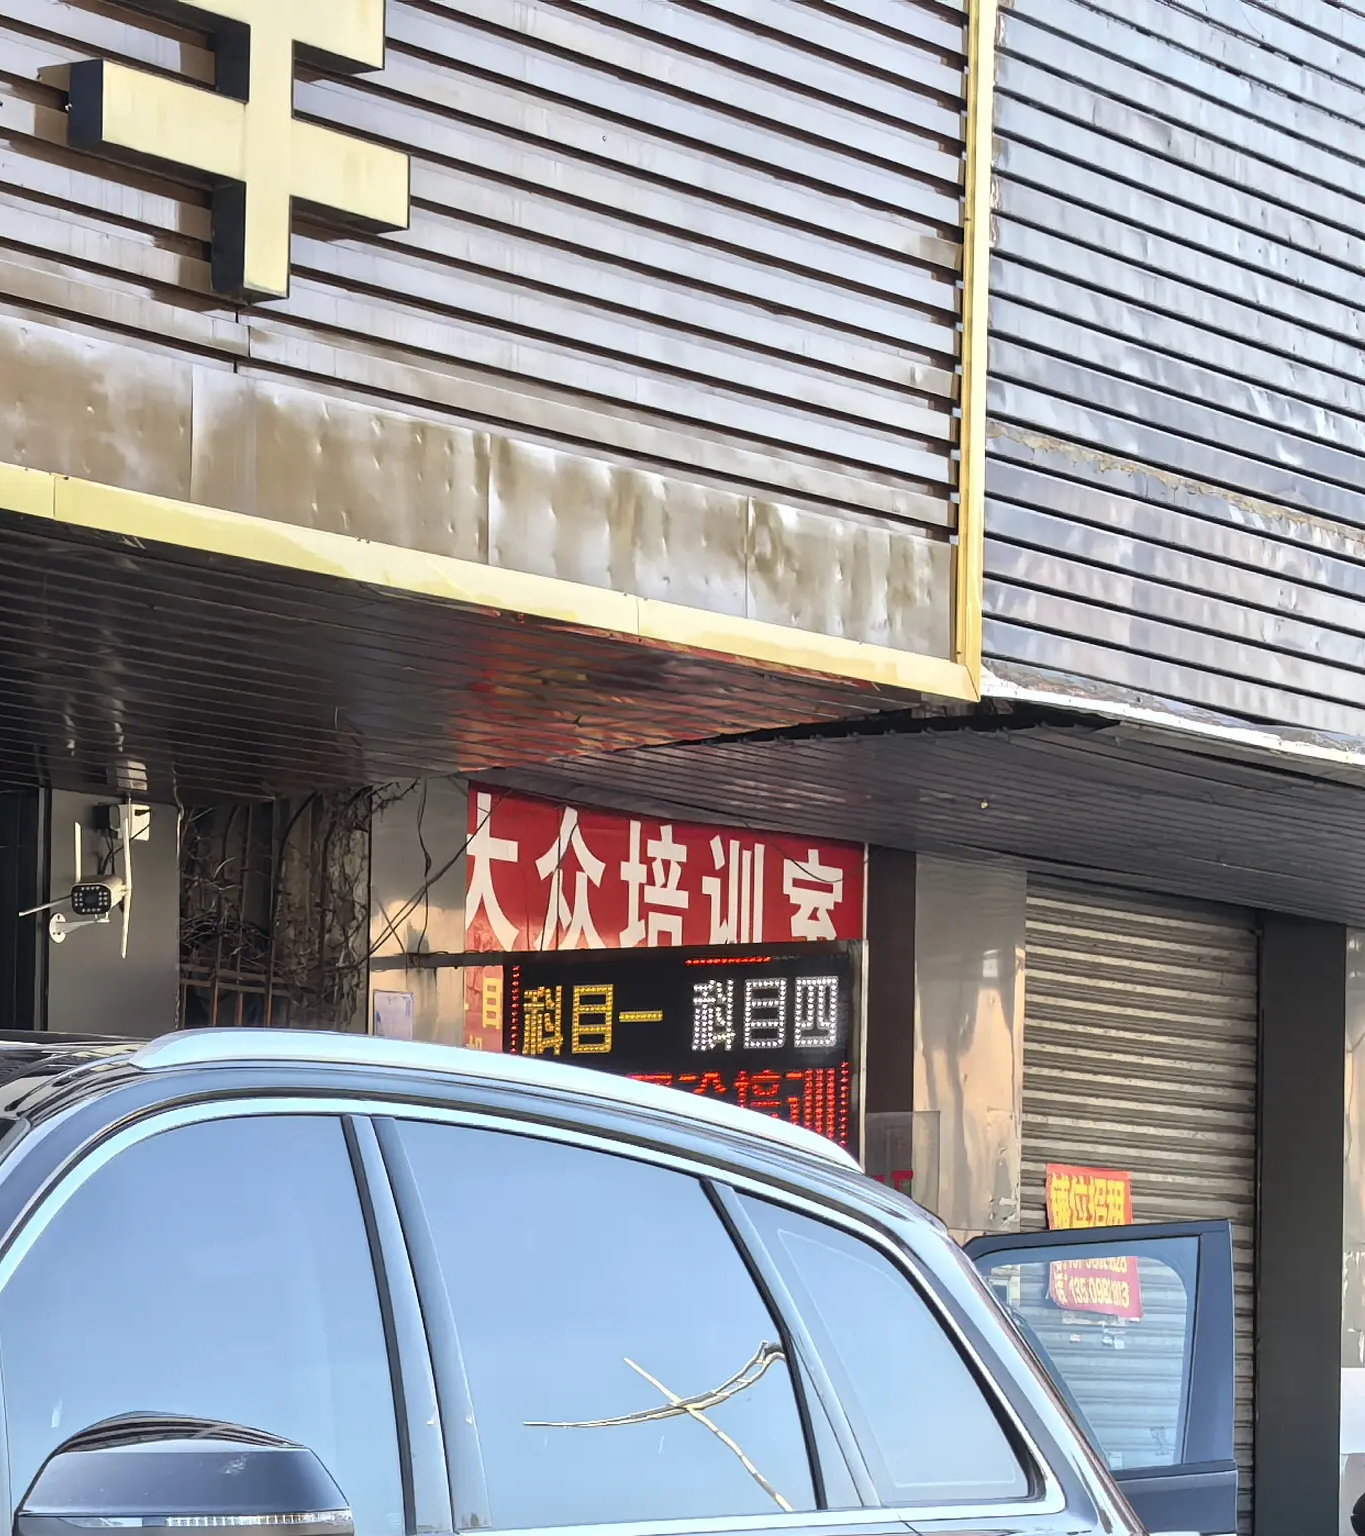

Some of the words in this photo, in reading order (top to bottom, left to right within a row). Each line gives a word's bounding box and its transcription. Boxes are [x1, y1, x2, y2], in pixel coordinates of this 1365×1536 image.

[466, 792, 844, 951] 大众培训室
[521, 983, 664, 1056] 科目一
[691, 974, 840, 1052] 科目四
